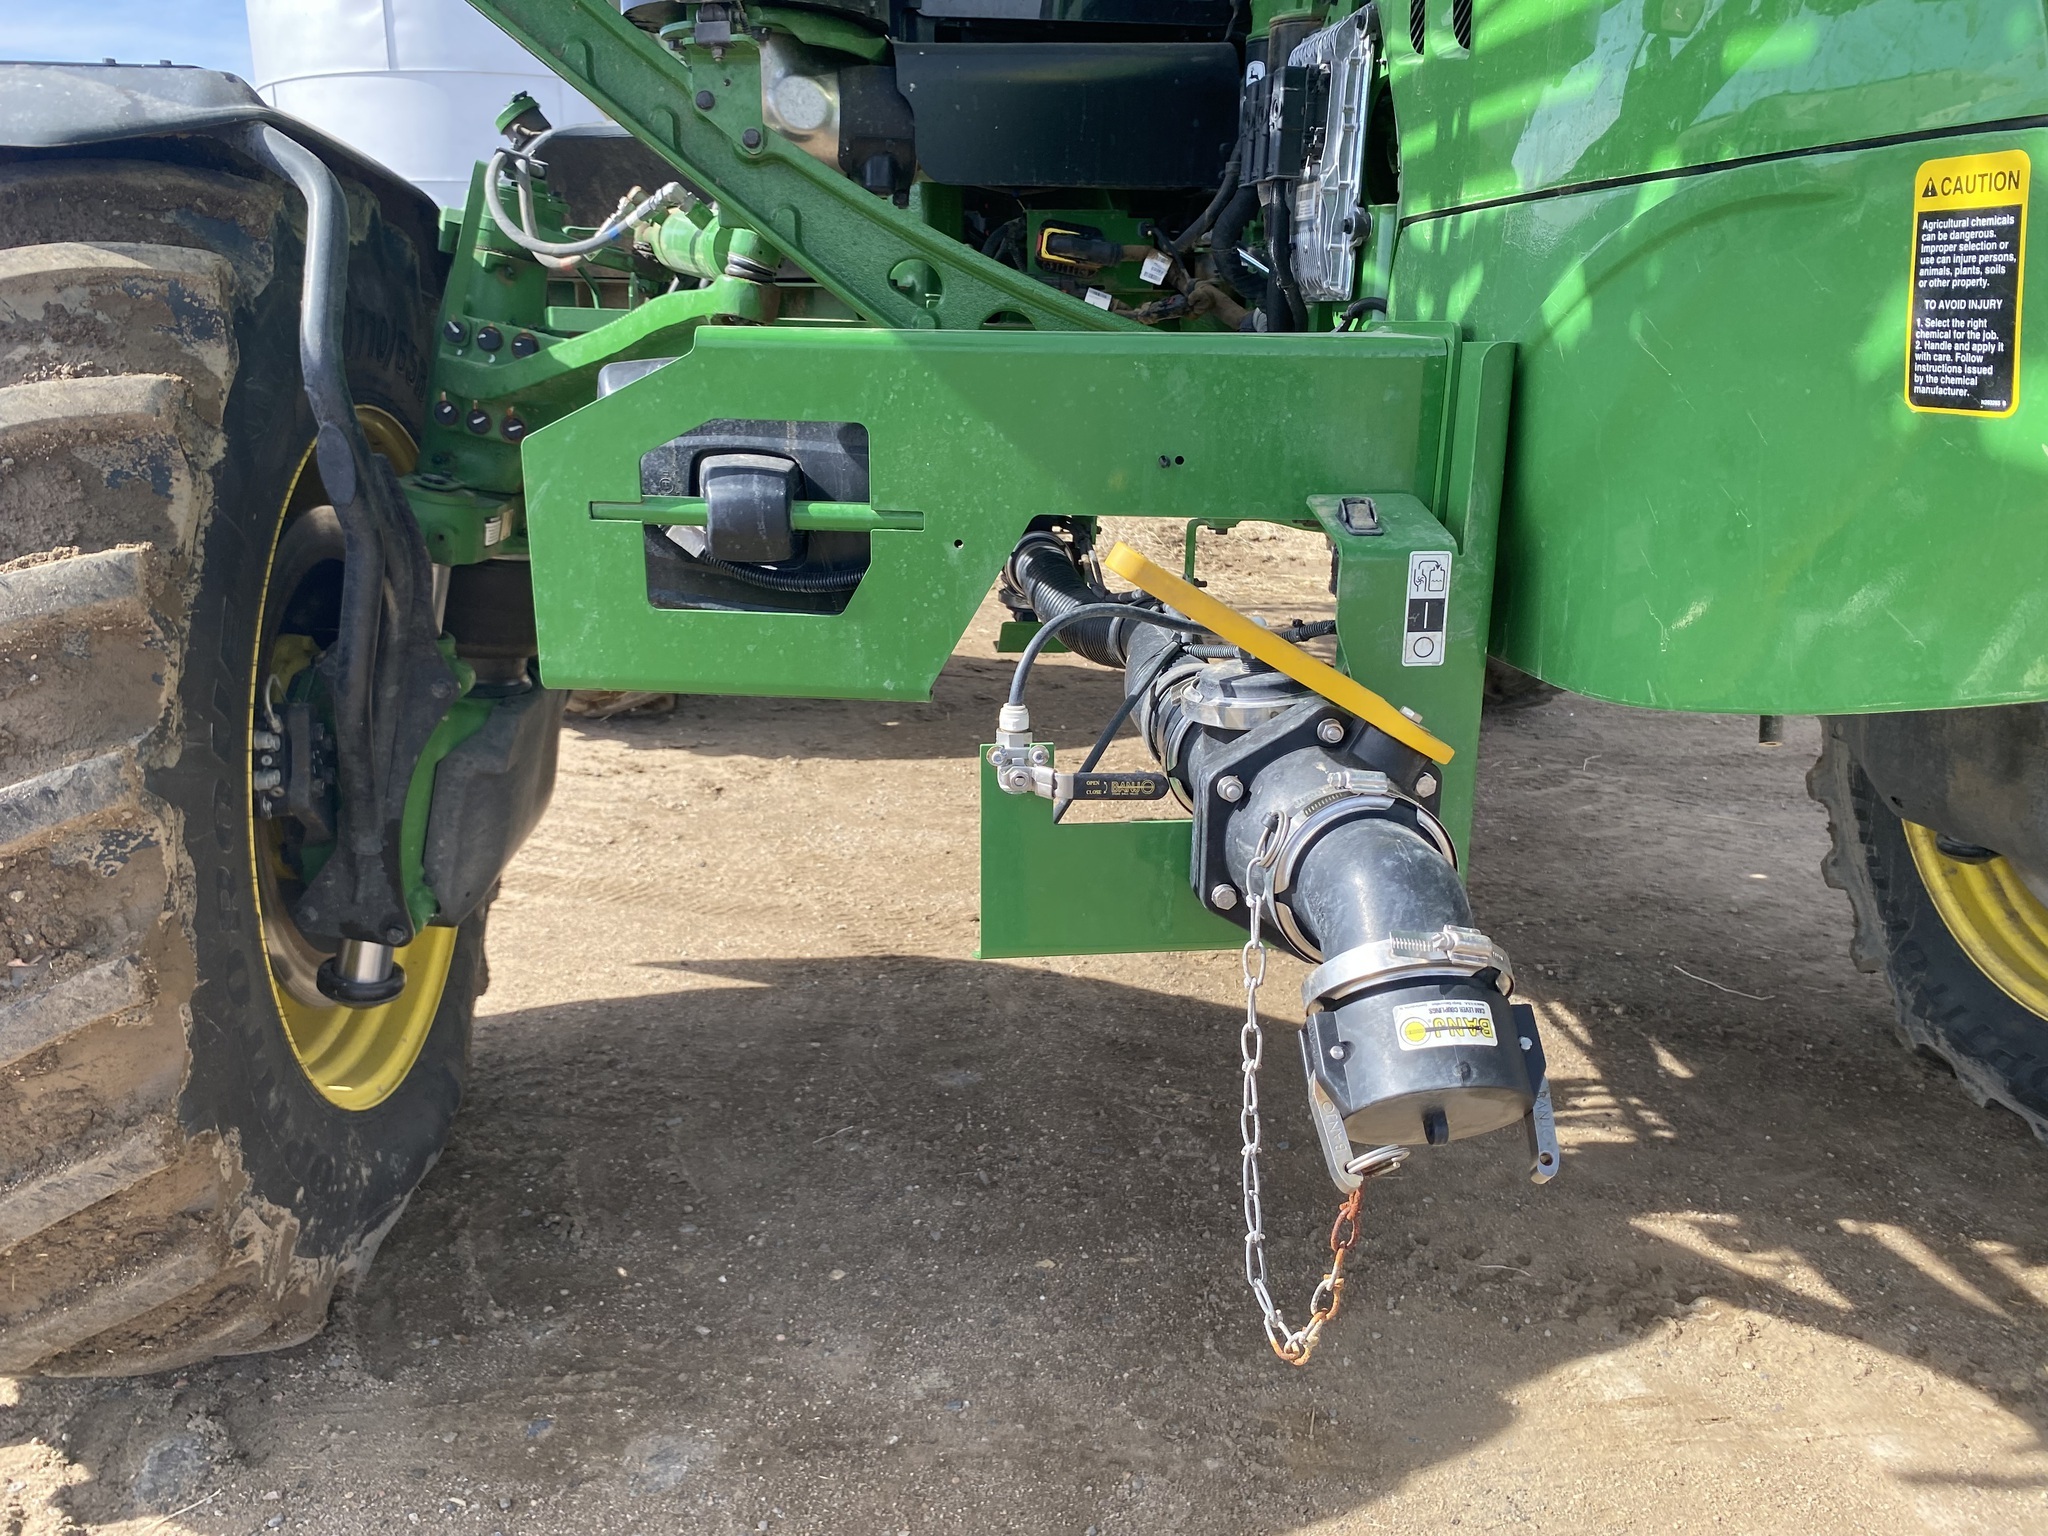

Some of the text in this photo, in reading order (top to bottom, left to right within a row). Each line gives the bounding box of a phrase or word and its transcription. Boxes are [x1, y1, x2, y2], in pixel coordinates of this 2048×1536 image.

[1941, 169, 2020, 196] CAUTION
[1922, 214, 2015, 231] Agricultural chemicals
[1921, 229, 1997, 242] can be dangerous.
[1921, 241, 2009, 255] Improper selection or
[1920, 252, 2017, 266] use can injure persons,
[1919, 264, 2006, 277] animals, plants, soils
[1918, 277, 1990, 289] or other property.
[1924, 299, 2003, 310] TO AVOID INJURY
[1916, 318, 1988, 330] 1. Select the right
[1915, 329, 1999, 342] chemical for the job.
[1915, 340, 2004, 354] 2. Handle and apply it
[1914, 351, 1984, 363] with care. Follow
[1914, 363, 1993, 375] instructions issued
[1914, 373, 1978, 386] by the chemical
[1913, 385, 1969, 397] manufacturer.
[1111, 779, 1155, 794] BANJO
[1428, 1006, 1459, 1014] COUPLINGS
[1459, 1006, 1474, 1014] LEVER
[1322, 1101, 1348, 1153] BANJO
